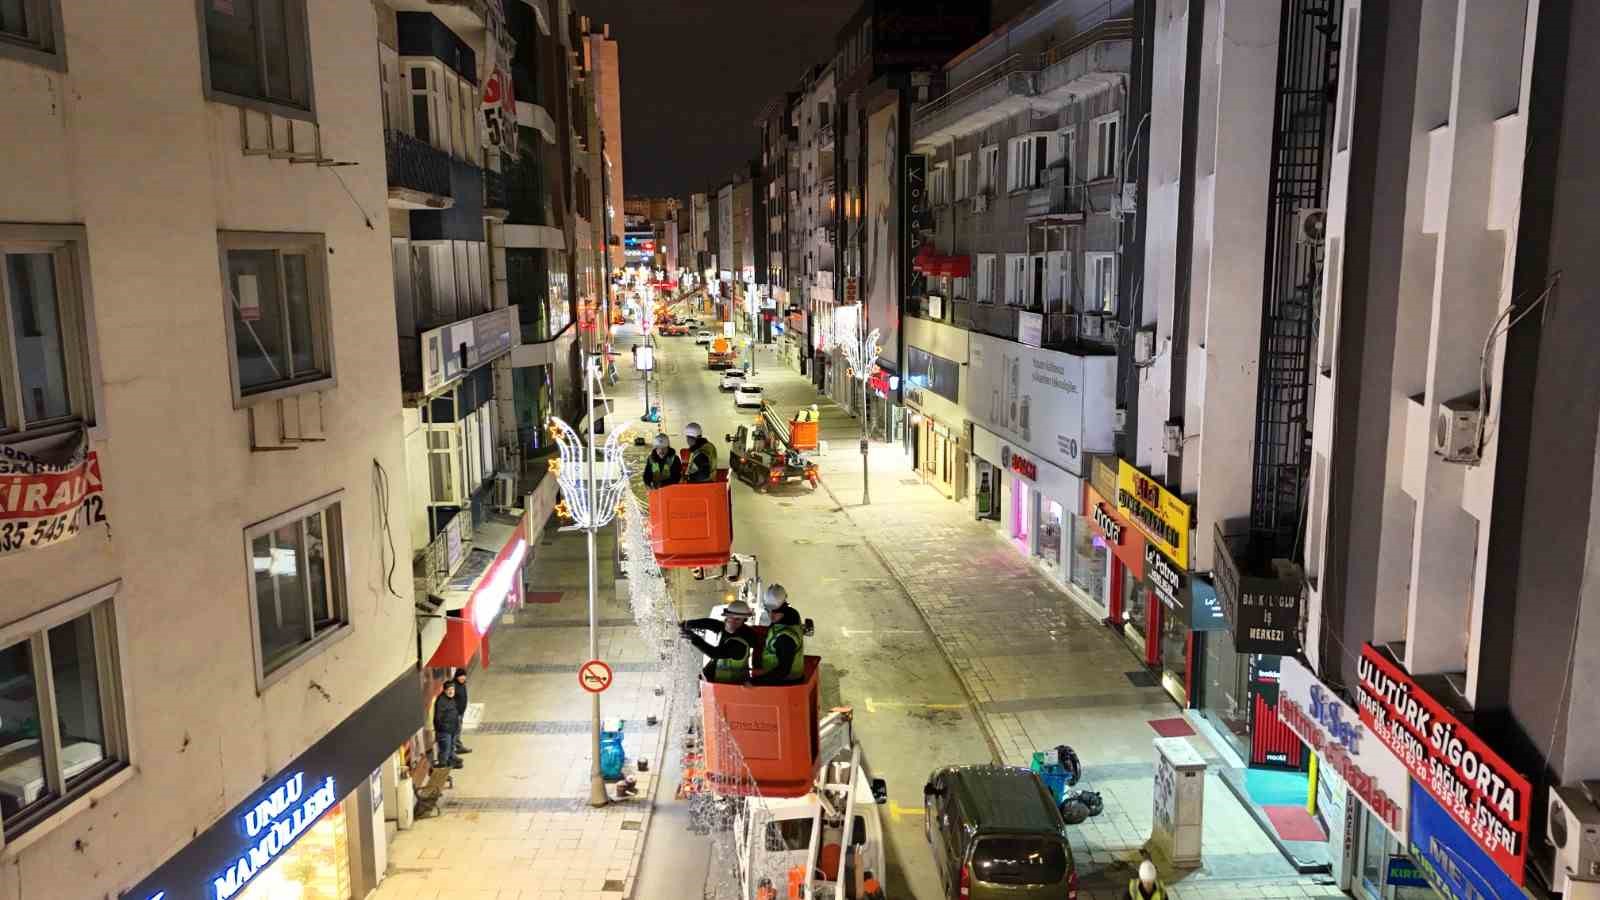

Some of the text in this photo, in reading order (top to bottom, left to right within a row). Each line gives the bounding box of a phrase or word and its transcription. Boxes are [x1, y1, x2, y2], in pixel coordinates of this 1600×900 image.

[1357, 655, 1516, 822] ULUTÜRK SİGORTA
[1391, 720, 1423, 760] KASKO
